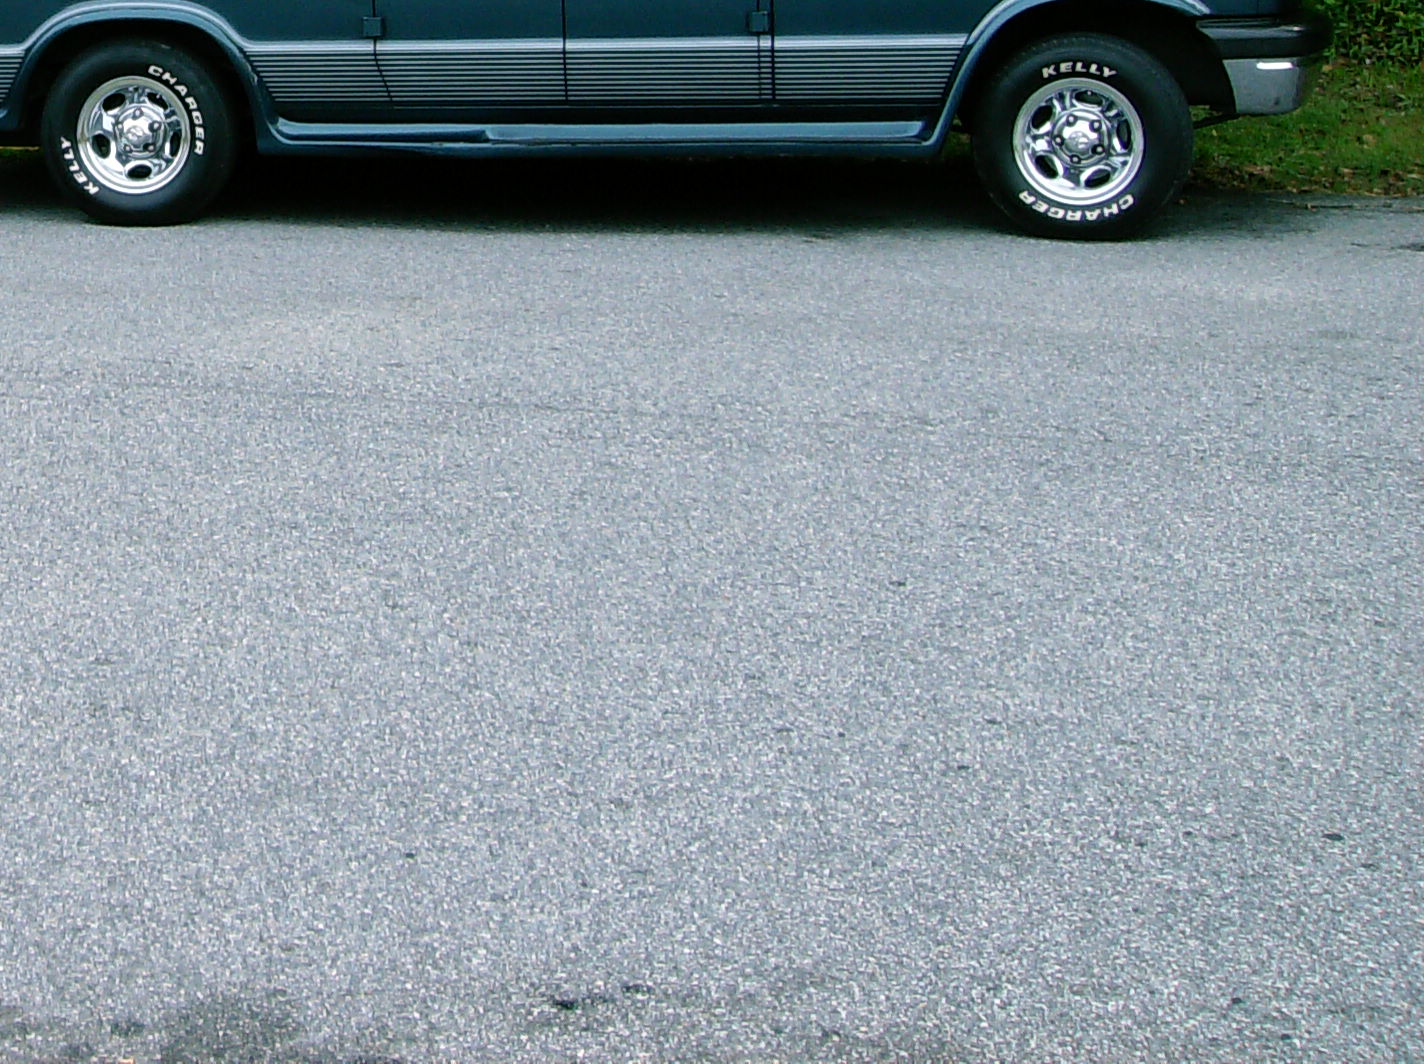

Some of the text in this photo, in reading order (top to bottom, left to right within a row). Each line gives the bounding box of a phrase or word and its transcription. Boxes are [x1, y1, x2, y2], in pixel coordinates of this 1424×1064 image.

[1041, 61, 1117, 78] KELLY
[147, 65, 205, 155] CHARGER
[60, 136, 100, 195] KELLY
[1018, 190, 1135, 221] CHARGER
